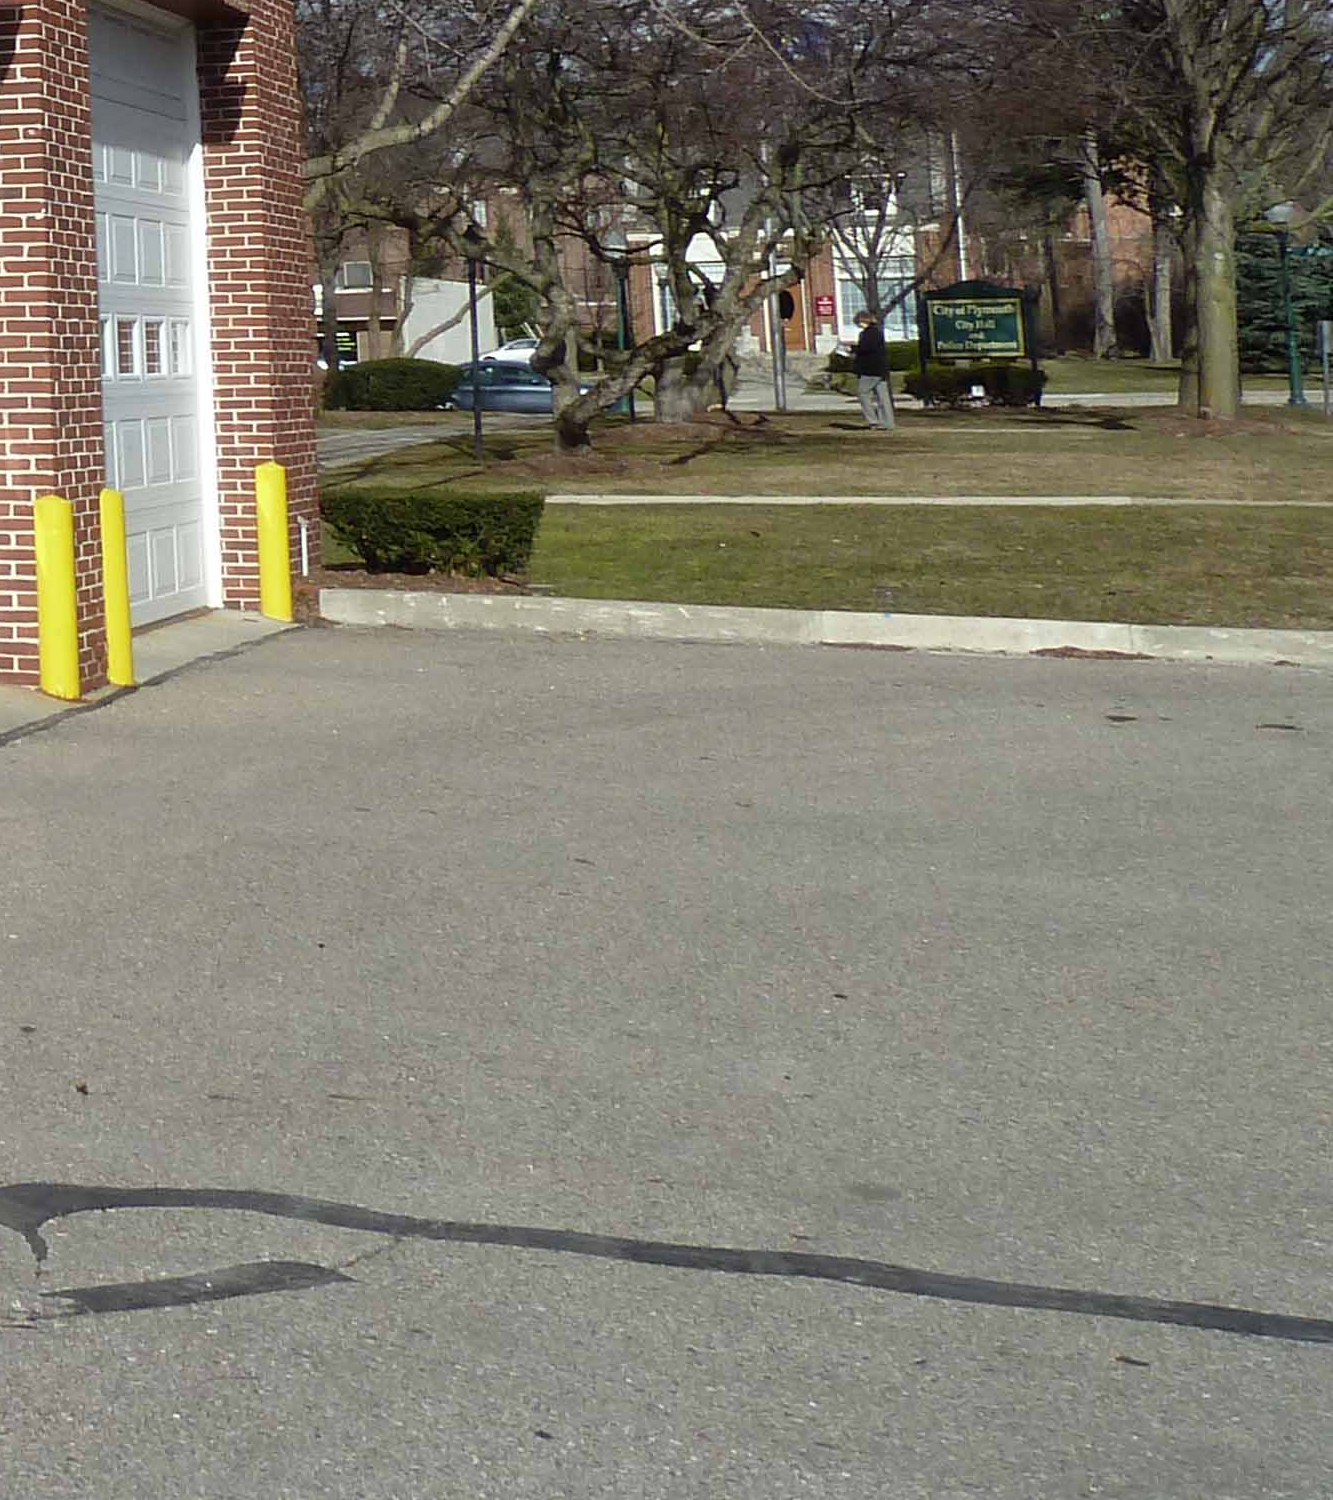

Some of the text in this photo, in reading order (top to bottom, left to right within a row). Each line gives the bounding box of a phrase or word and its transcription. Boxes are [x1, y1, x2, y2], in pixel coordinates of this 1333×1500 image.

[933, 305, 953, 318] City
[966, 304, 1014, 317] Plymouth
[955, 319, 996, 331] City Hall
[965, 340, 1017, 350] Department
